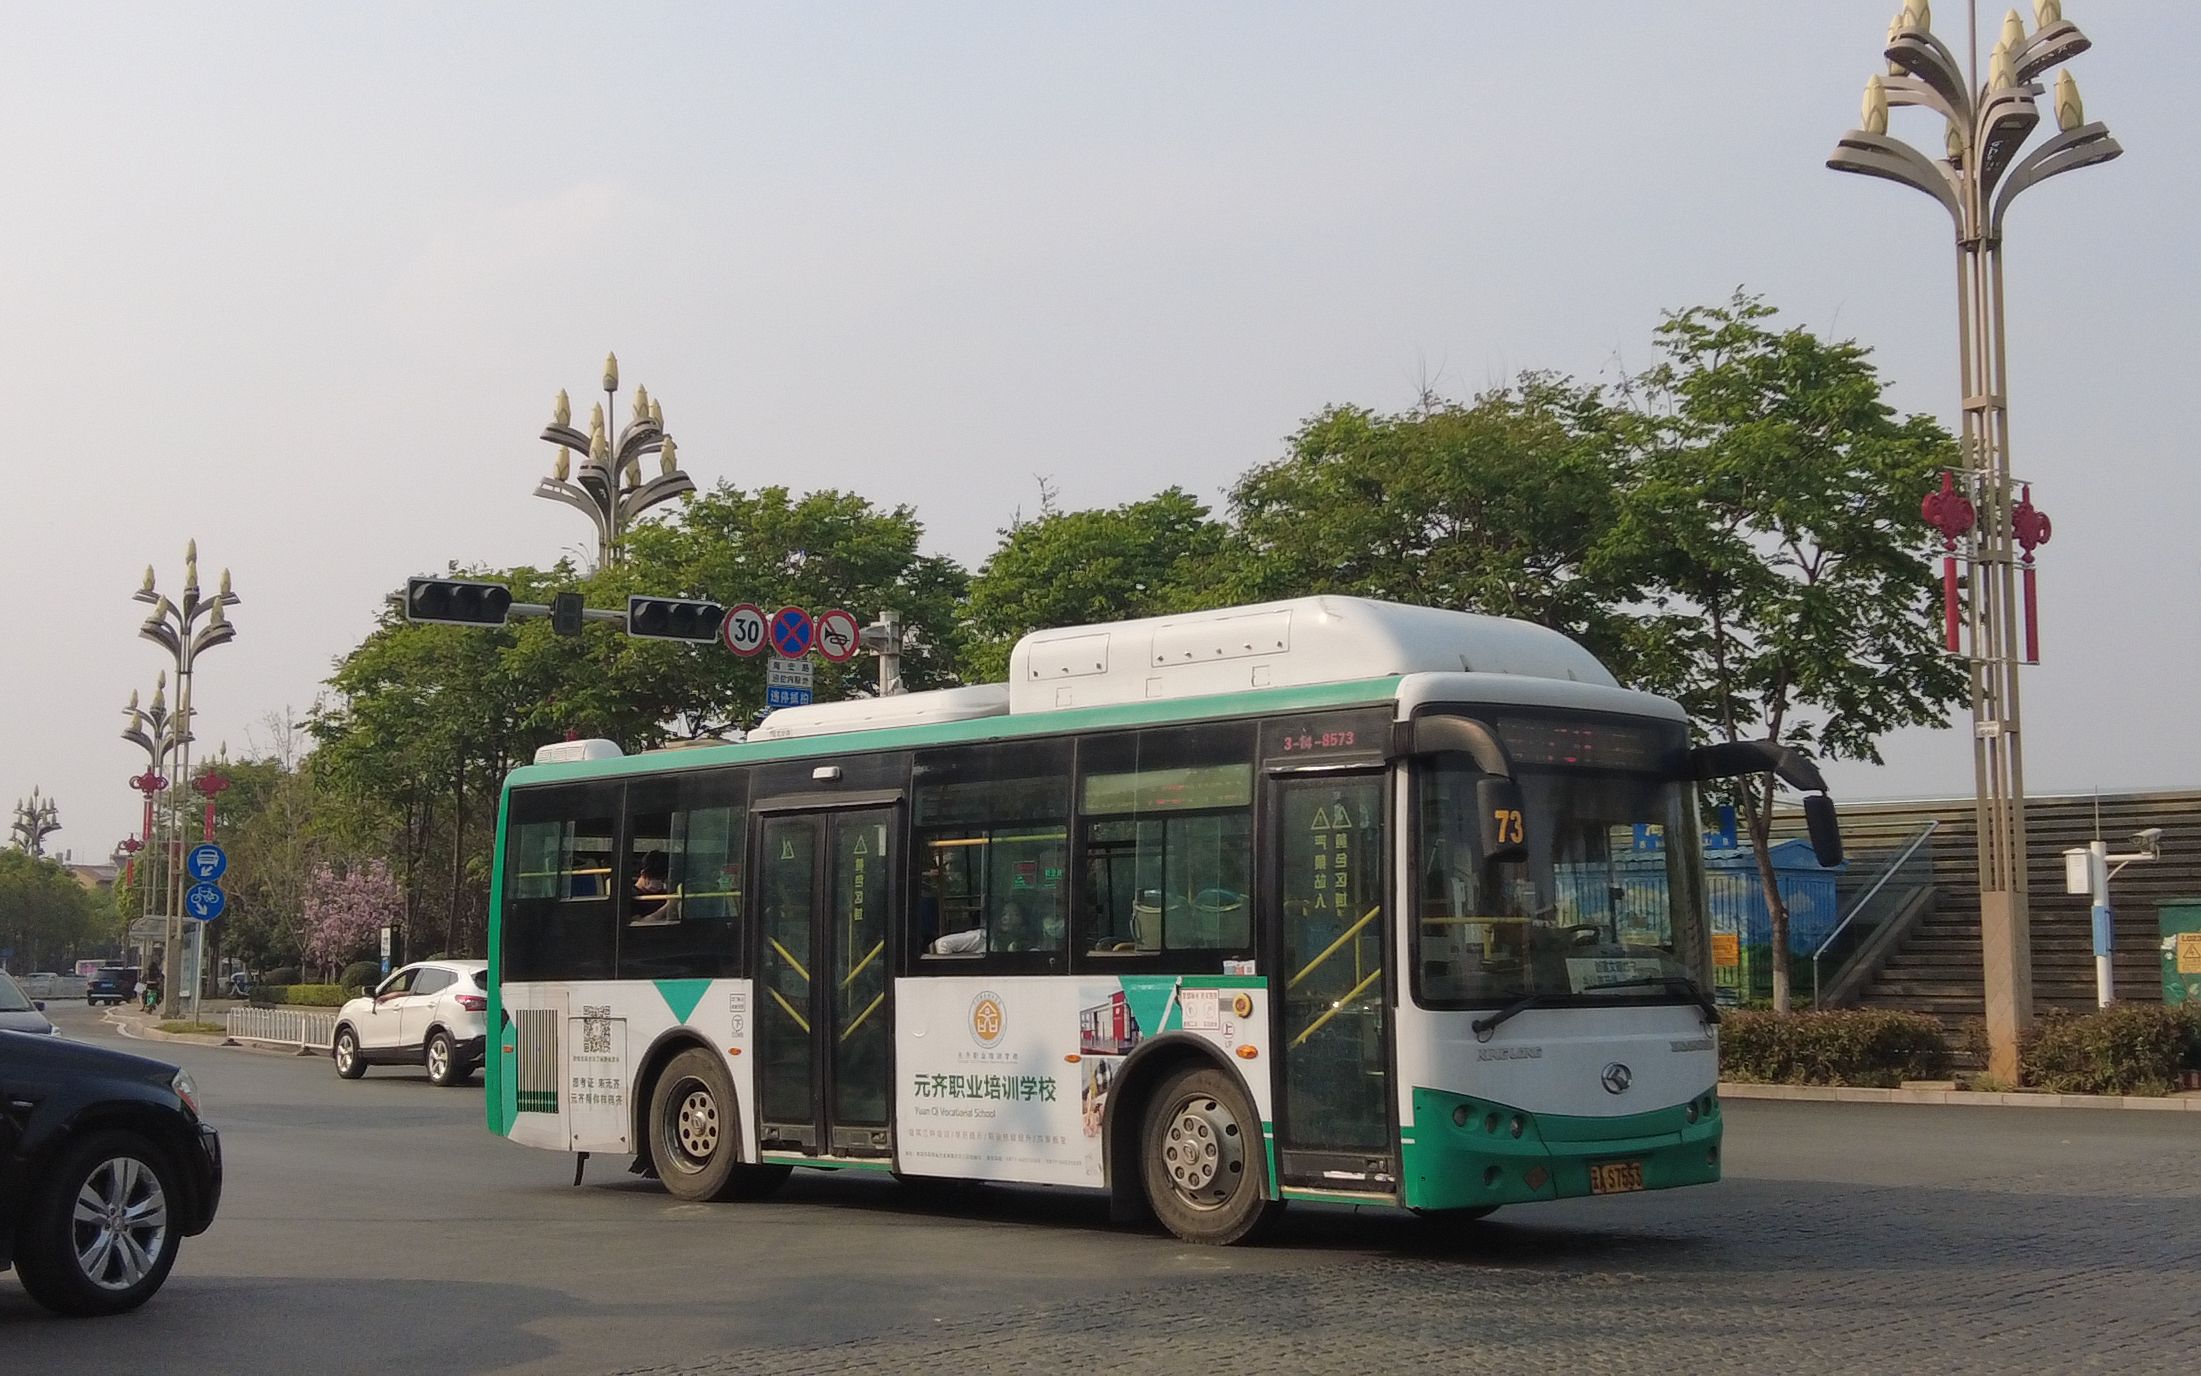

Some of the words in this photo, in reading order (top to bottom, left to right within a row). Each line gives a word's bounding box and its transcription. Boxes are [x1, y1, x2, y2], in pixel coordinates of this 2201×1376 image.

[734, 617, 761, 643] 30
[1493, 808, 1525, 845] 73
[913, 1073, 1057, 1102] 元齐职业培训学校
[974, 1107, 996, 1119] School
